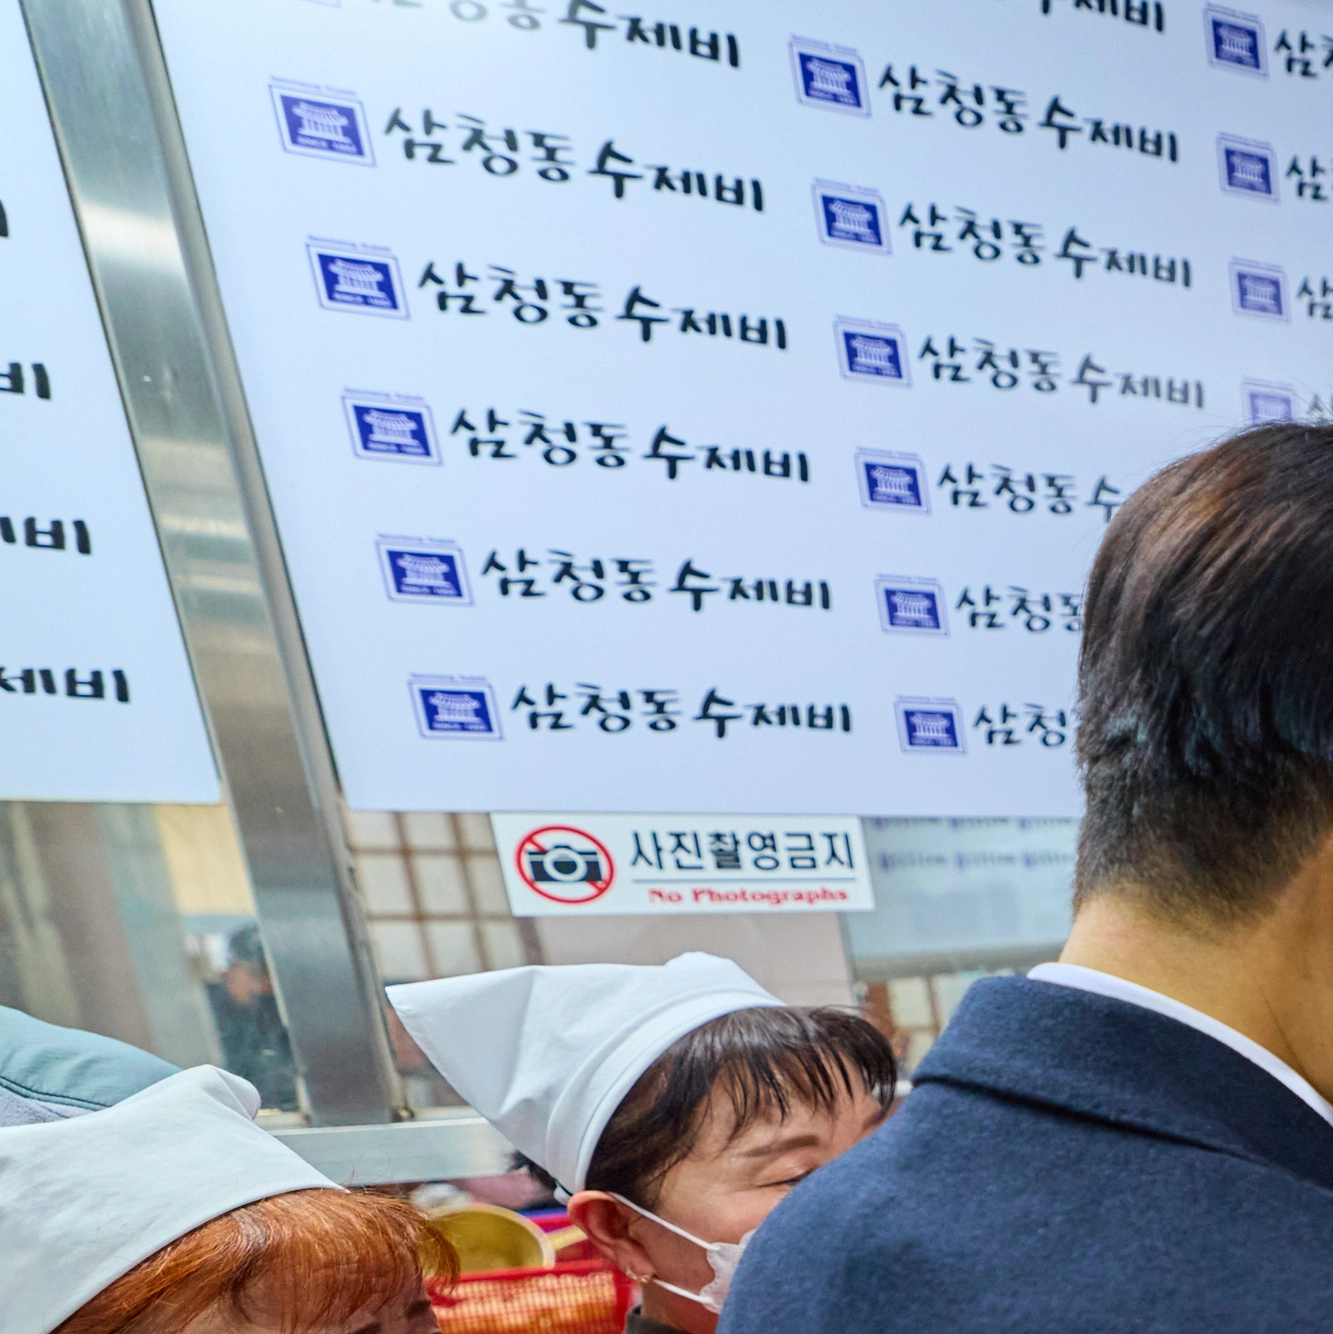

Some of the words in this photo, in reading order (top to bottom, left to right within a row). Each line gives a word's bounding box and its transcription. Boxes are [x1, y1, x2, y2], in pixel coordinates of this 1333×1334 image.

[632, 832, 853, 870] 사진촬영금지
[649, 888, 682, 904] No
[691, 886, 848, 905] Photographs
